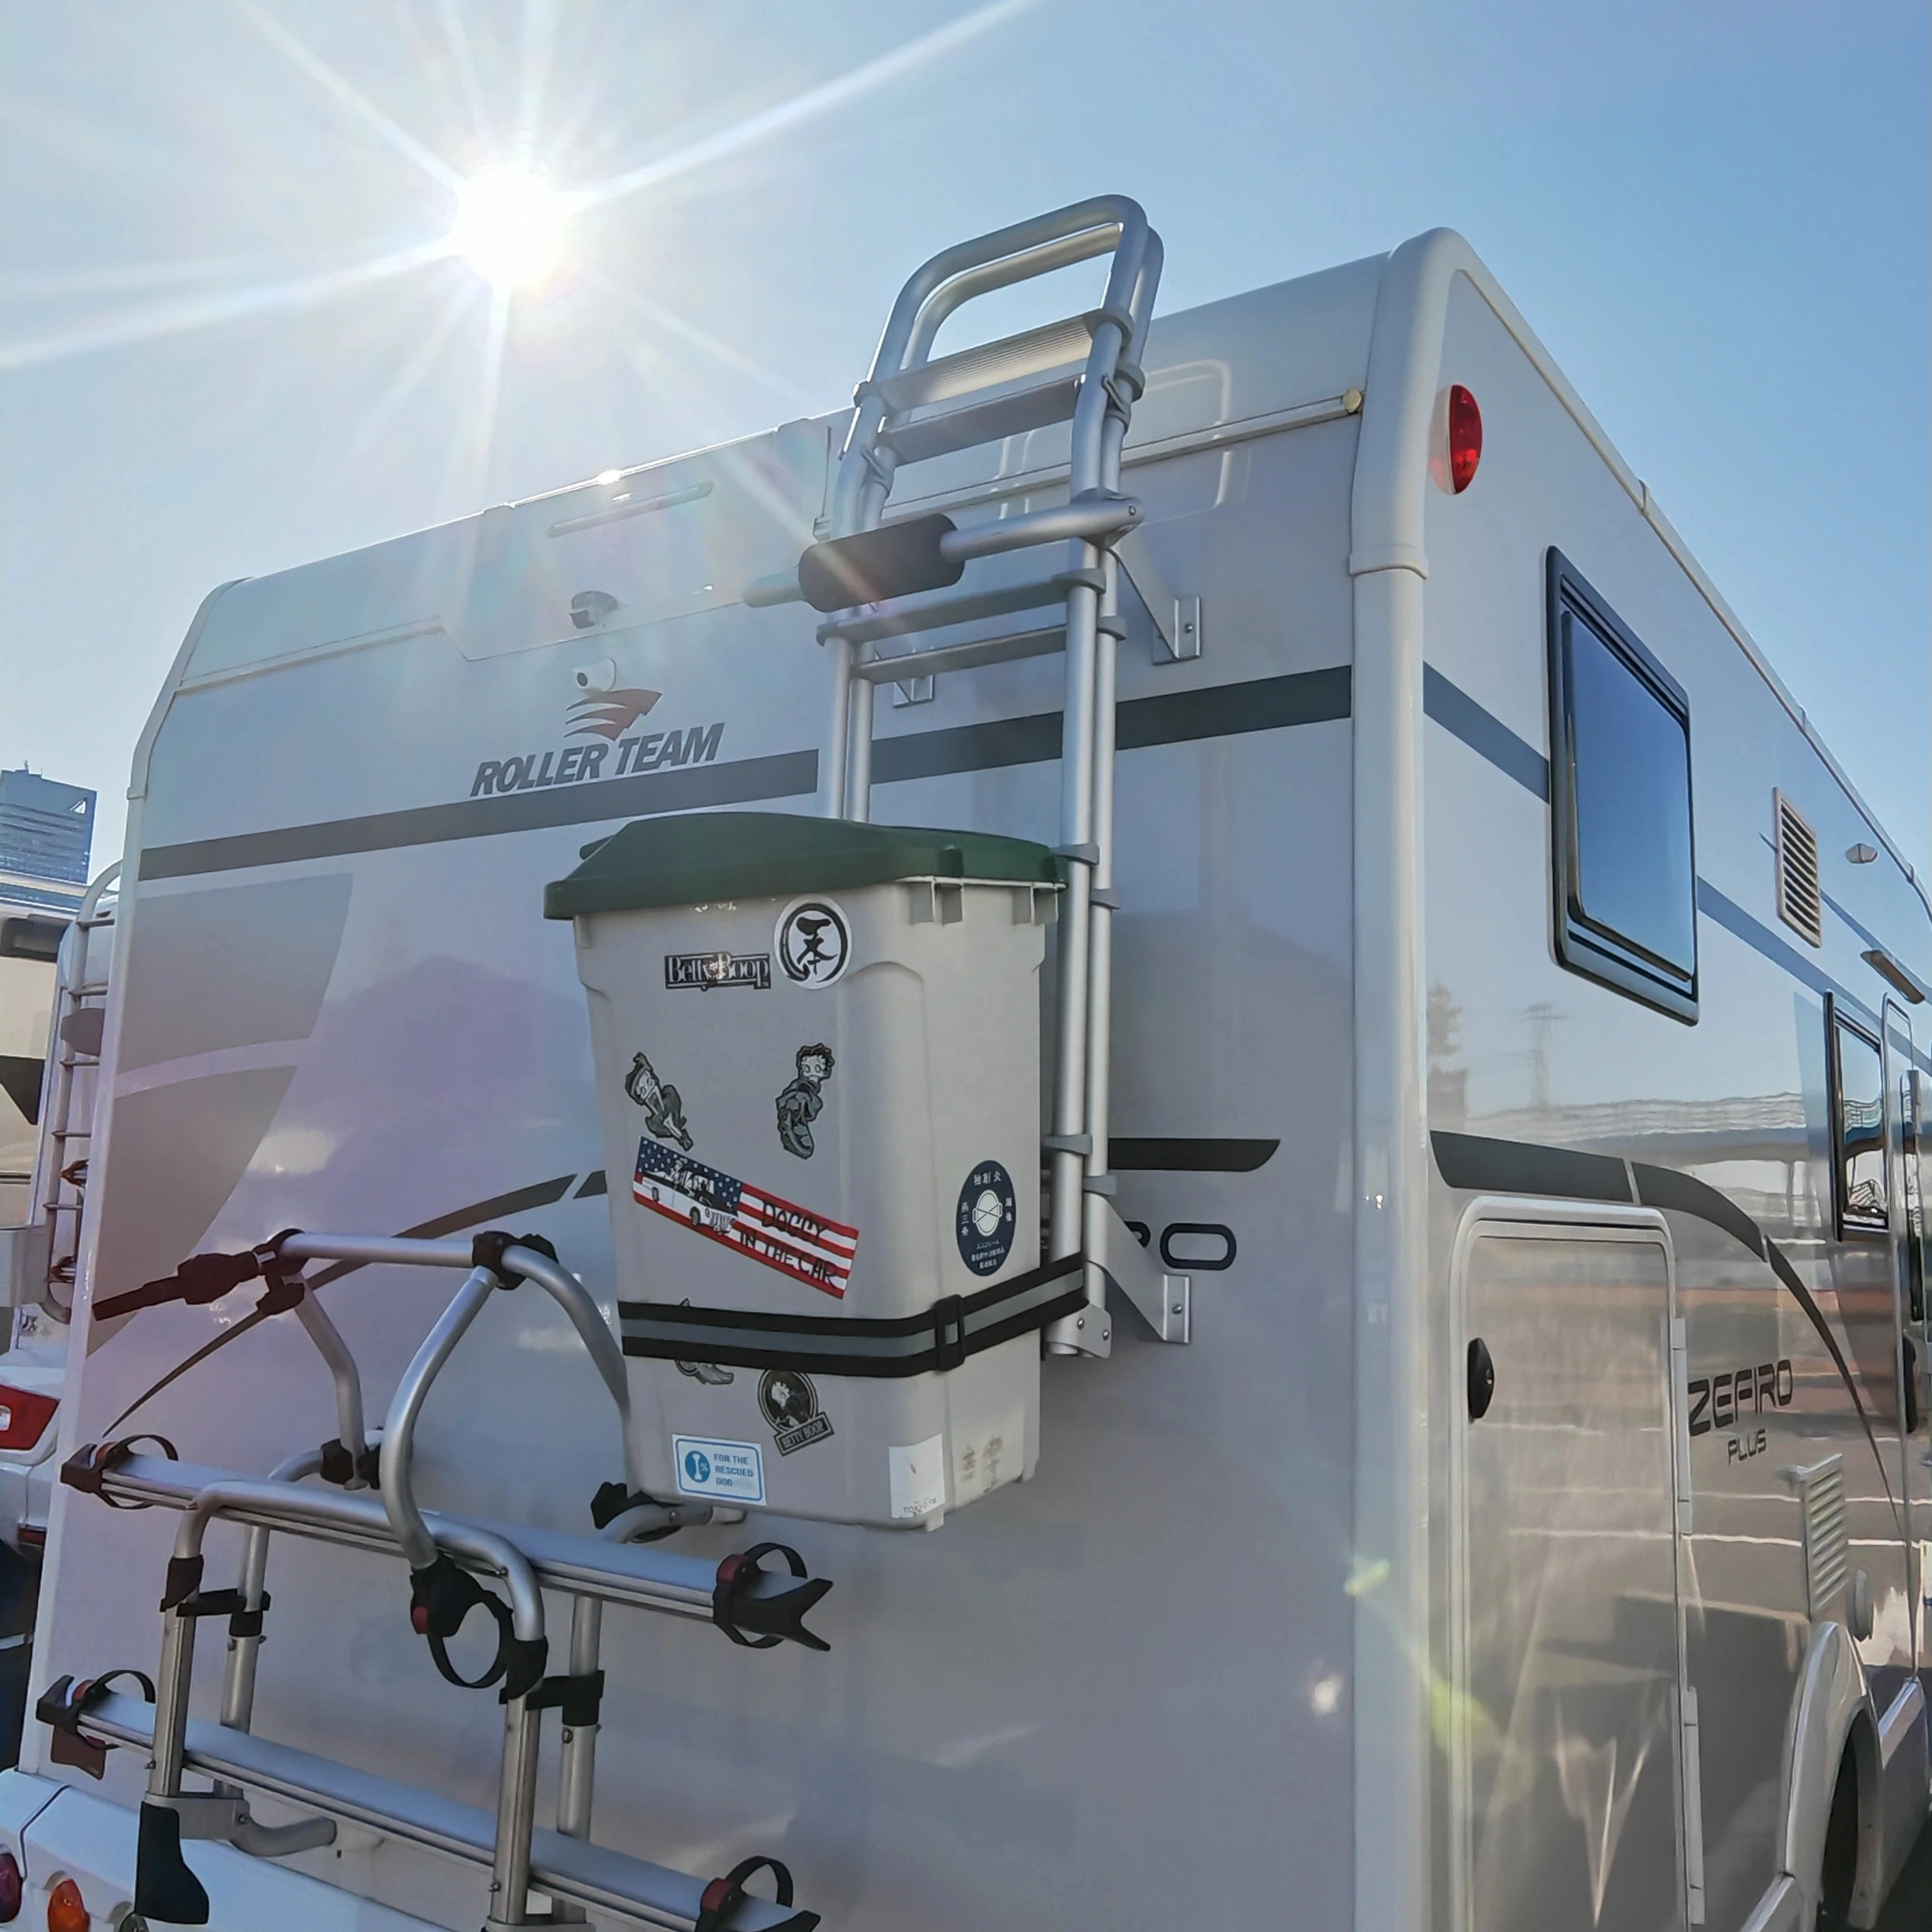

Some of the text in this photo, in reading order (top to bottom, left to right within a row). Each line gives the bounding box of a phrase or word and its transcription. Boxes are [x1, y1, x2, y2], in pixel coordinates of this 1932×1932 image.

[469, 722, 725, 797] ROLLER TEAM
[762, 1200, 828, 1246] DOGGY
[740, 1227, 844, 1289] IN THE CAR
[1687, 1359, 1793, 1437] ZEFIRO
[782, 1421, 824, 1448] BETTY BOOP
[1728, 1428, 1767, 1467] PLUS
[714, 1453, 748, 1465] FOR THE
[714, 1465, 753, 1477] RESCUED
[716, 1477, 733, 1486] DOG
[902, 1501, 928, 1513] TOKYO
